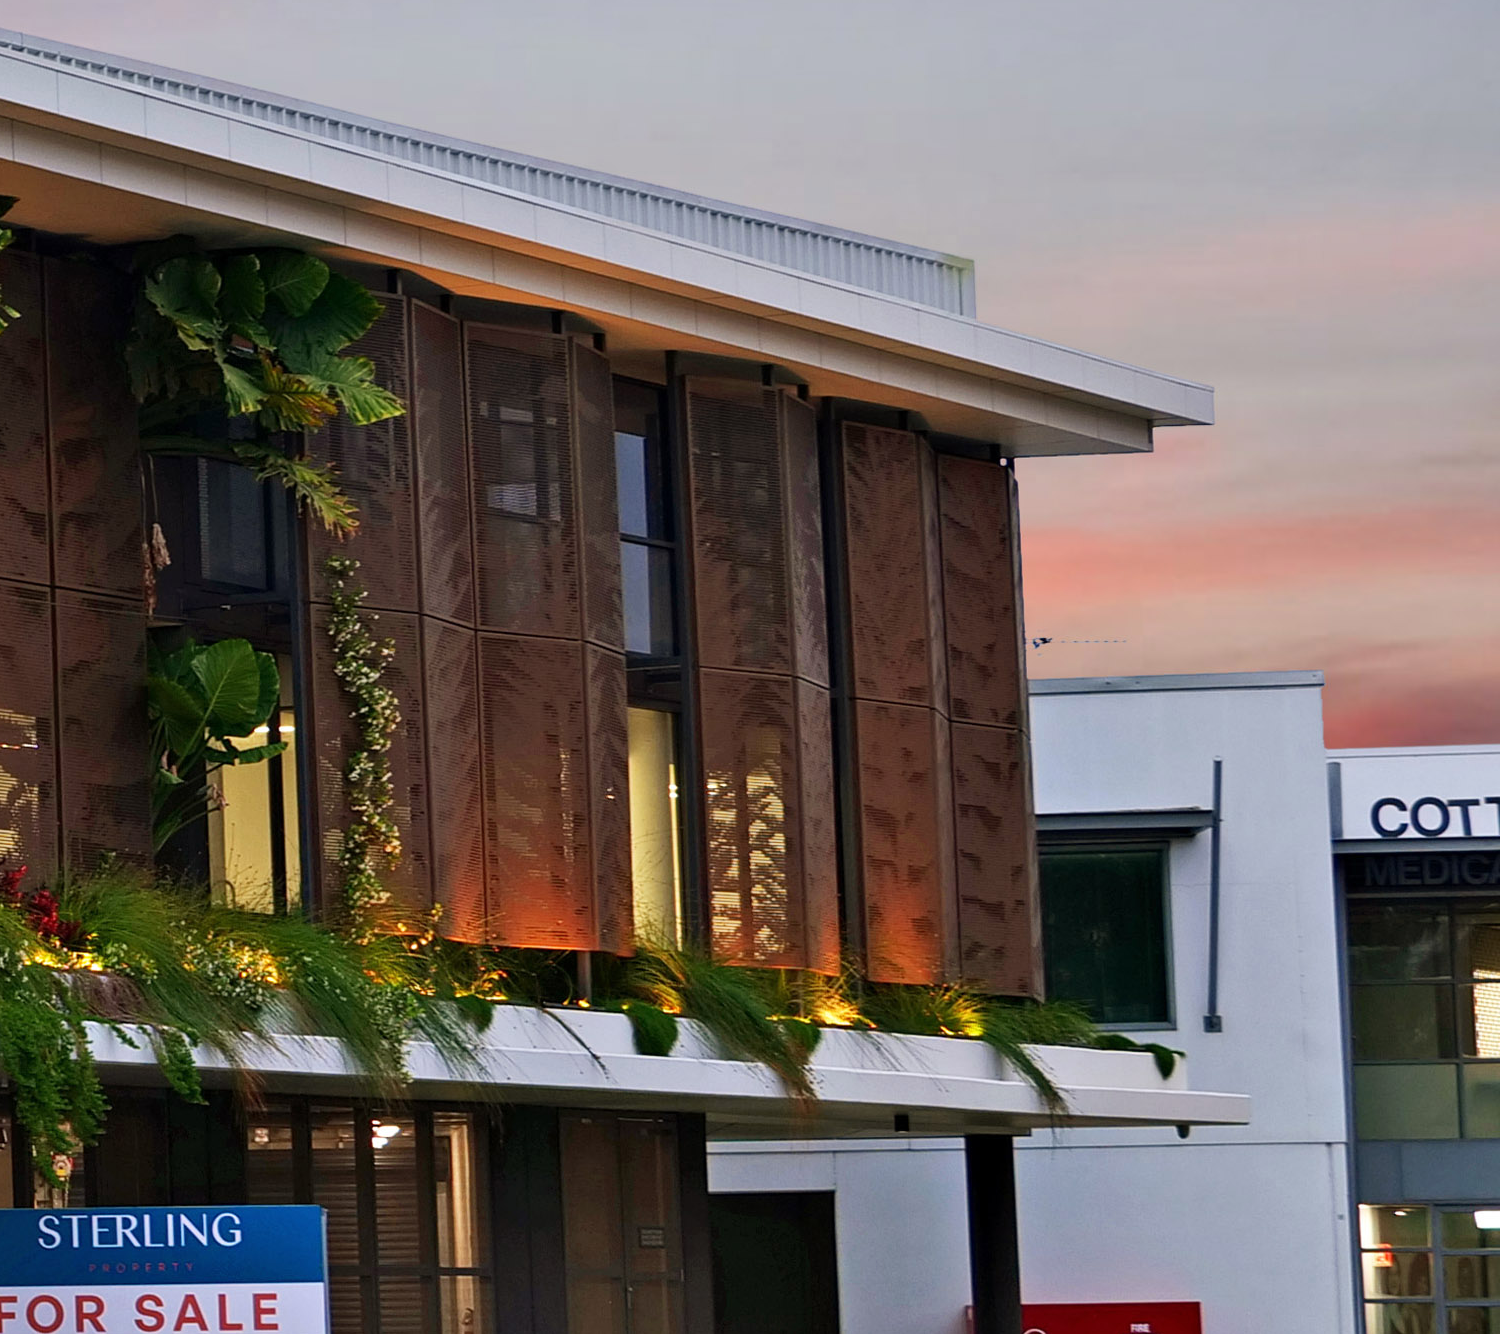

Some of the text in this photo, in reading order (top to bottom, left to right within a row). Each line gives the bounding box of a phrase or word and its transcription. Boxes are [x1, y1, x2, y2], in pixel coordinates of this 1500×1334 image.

[38, 1212, 242, 1249] STERLING
[89, 1262, 194, 1273] PROPERTY
[134, 1293, 280, 1332] SALE
[1130, 1323, 1150, 1333] FIRE
